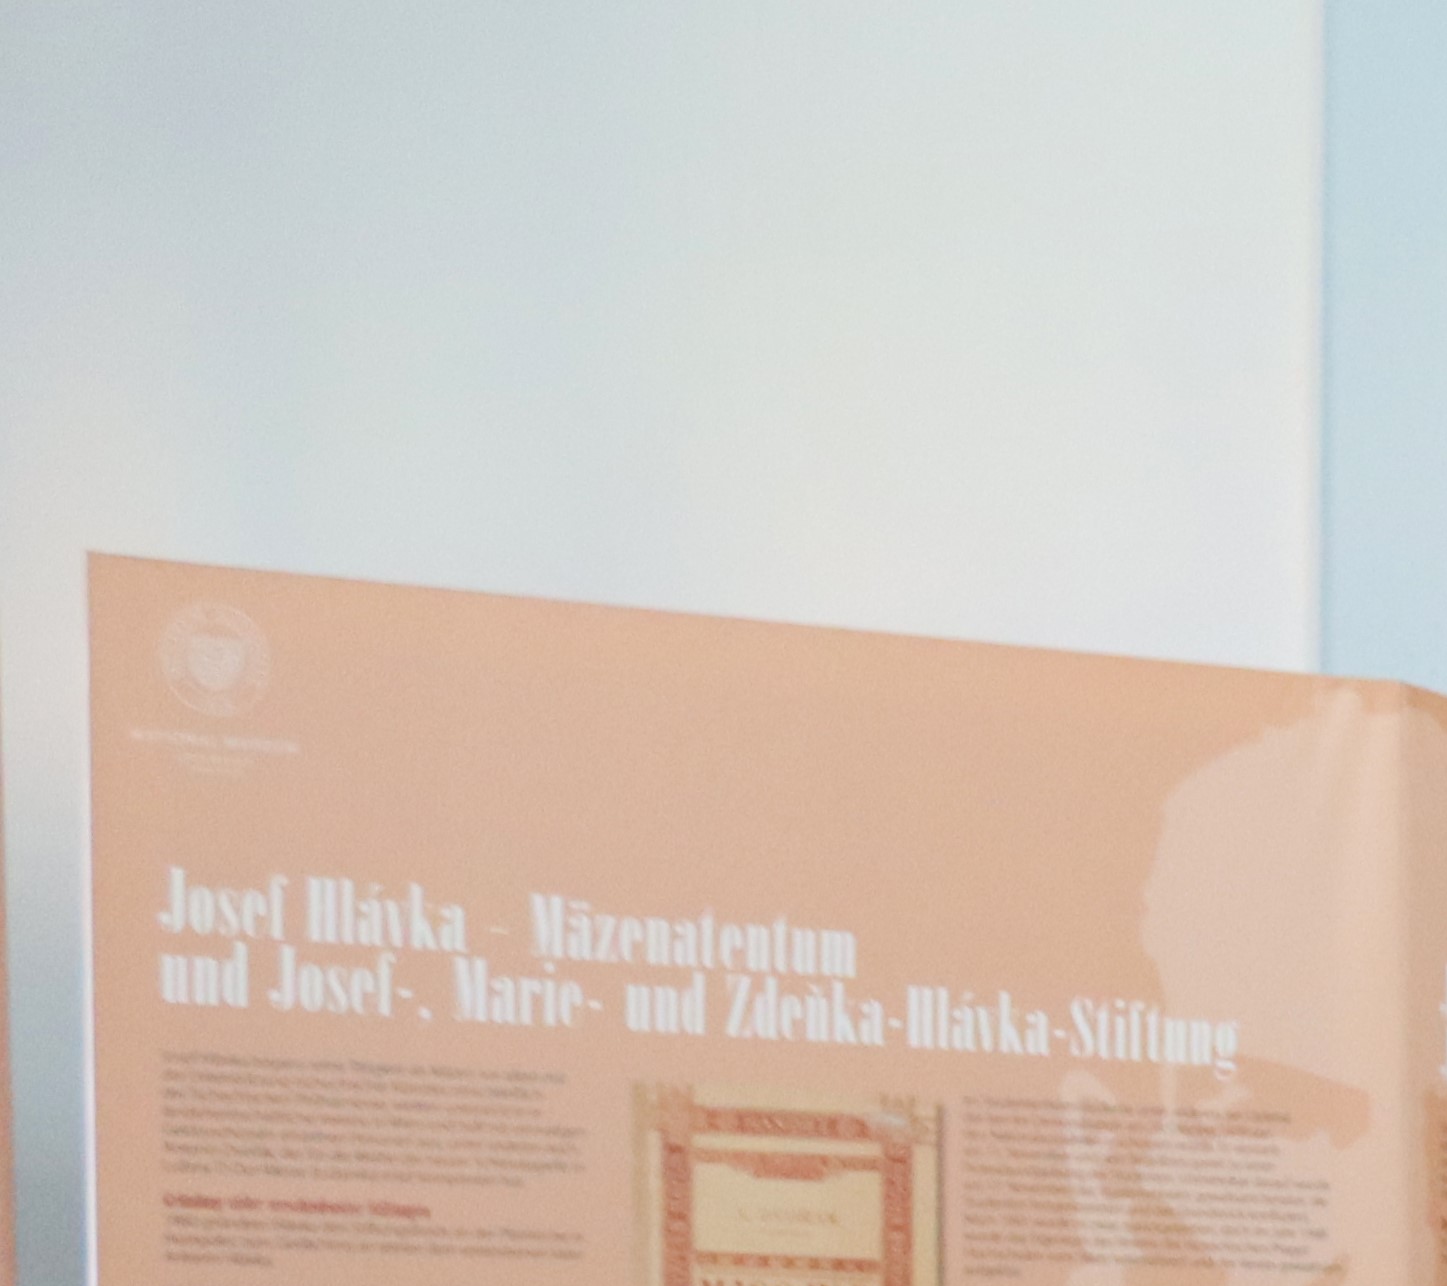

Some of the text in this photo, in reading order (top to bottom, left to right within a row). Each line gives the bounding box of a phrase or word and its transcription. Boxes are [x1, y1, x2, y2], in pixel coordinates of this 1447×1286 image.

[157, 865, 289, 941] Josef
[306, 875, 468, 953] Hlávka
[160, 940, 248, 1009] und
[624, 970, 706, 1036] und
